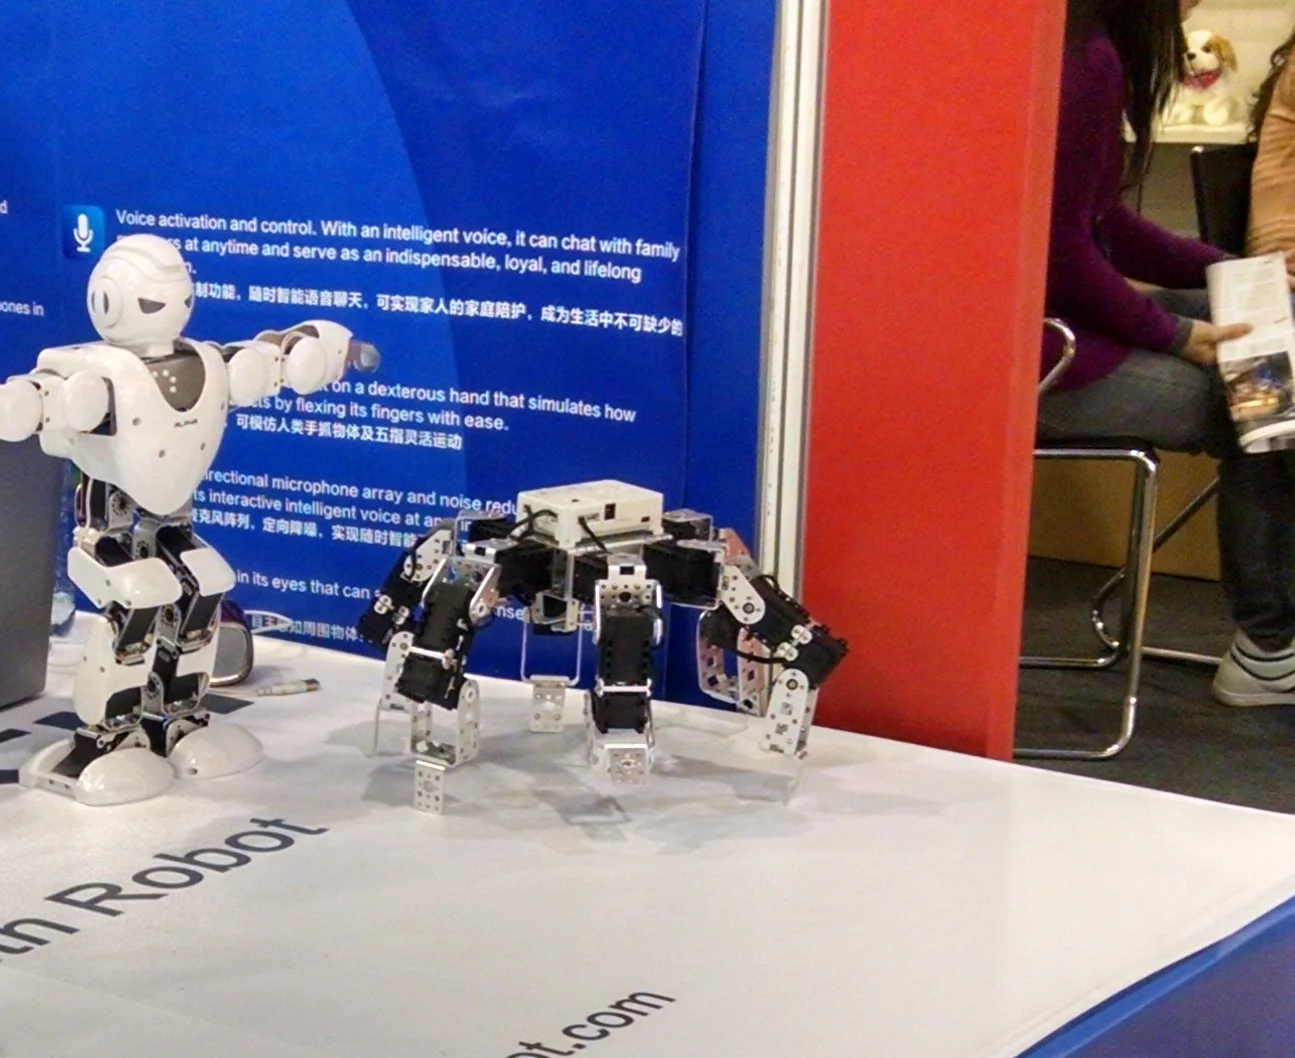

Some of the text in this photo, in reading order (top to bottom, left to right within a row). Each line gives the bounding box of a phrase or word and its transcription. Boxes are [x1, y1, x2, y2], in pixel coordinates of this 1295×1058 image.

[116, 208, 680, 263] Voice activation and control. With an intelligent voice, it can chat with family
[185, 238, 199, 252] at
[202, 239, 258, 258] anytime
[262, 241, 289, 258] and
[293, 245, 336, 260] serve
[341, 247, 359, 261] as
[364, 248, 382, 262] an
[386, 247, 501, 271] indispensable,
[505, 254, 547, 274] loyal,
[551, 258, 580, 275] and
[584, 260, 641, 284] lifelong
[33, 302, 44, 316] in
[275, 397, 291, 413] by
[295, 398, 346, 418] flexing
[349, 403, 367, 417] its
[371, 403, 424, 423] fingers
[427, 410, 460, 426] with
[464, 413, 509, 431] ease.
[332, 380, 350, 393] on
[355, 382, 365, 394] a
[368, 381, 445, 402] dexterous
[449, 387, 490, 406] hand
[493, 391, 524, 409] that
[528, 394, 601, 418] simulates
[605, 403, 637, 422] how
[209, 489, 282, 512] interactive
[285, 498, 357, 520] intelligent
[360, 509, 400, 525] voice
[405, 513, 420, 526] at
[272, 476, 358, 498] microphone
[362, 486, 403, 505] array
[407, 491, 436, 506] and
[439, 494, 482, 511] noise
[237, 570, 371, 600] in its eyes that can
[46, 816, 329, 917] Robot
